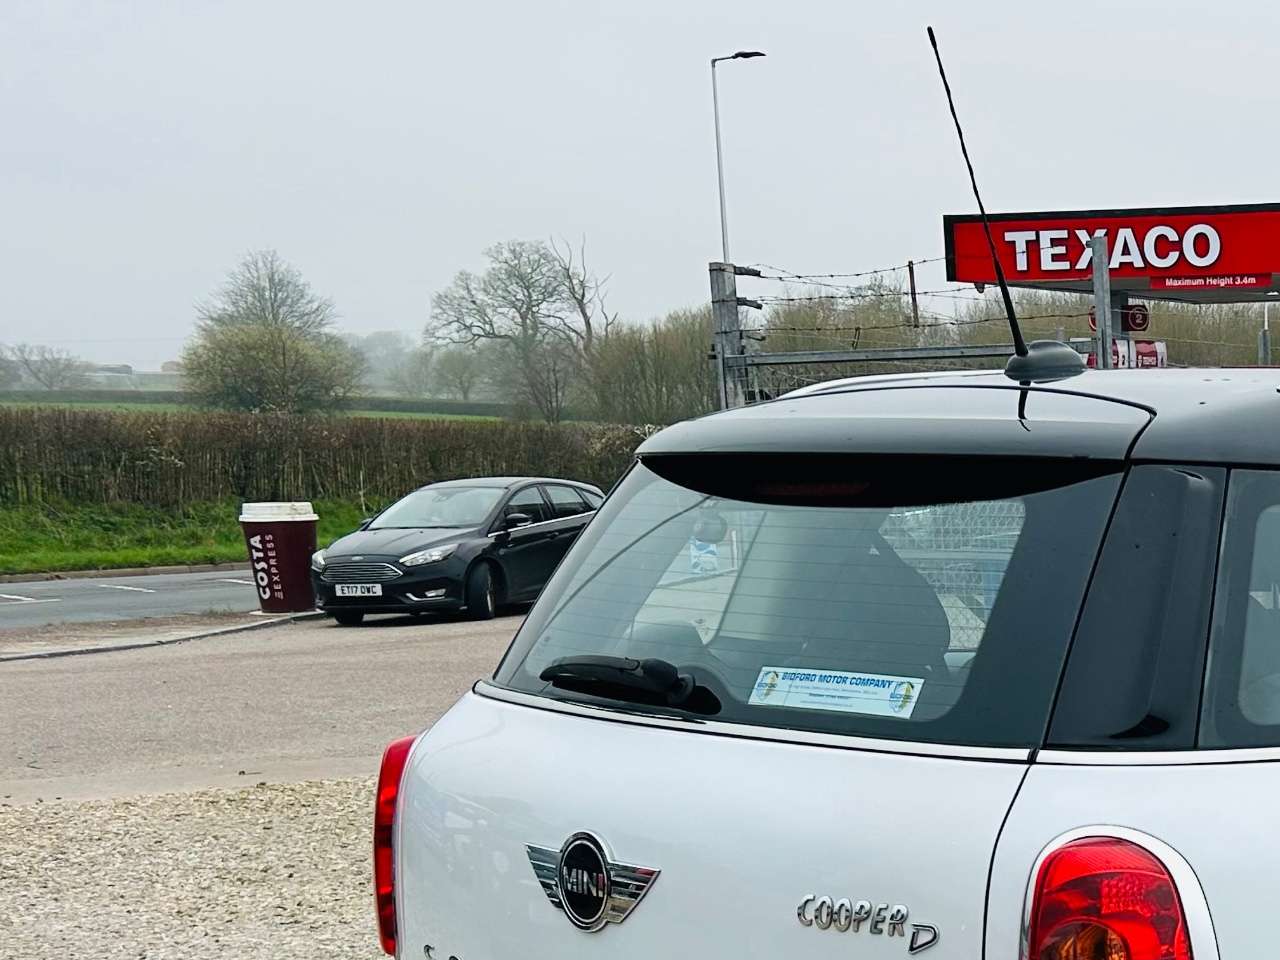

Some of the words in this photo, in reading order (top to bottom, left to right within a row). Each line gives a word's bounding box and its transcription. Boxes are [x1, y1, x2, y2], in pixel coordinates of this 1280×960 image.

[1005, 223, 1221, 271] TEXACO
[1165, 278, 1204, 287] Maximum
[1206, 277, 1233, 286] Height
[1235, 276, 1256, 285] 3.4m
[1135, 314, 1143, 324] 2
[250, 535, 271, 600] COSTA
[265, 534, 282, 590] EXPRESS
[818, 674, 849, 686] MOTOR
[849, 676, 894, 689] COMPANY
[563, 866, 604, 898] MINI
[797, 894, 909, 937] COOPER
[908, 922, 940, 955] D
